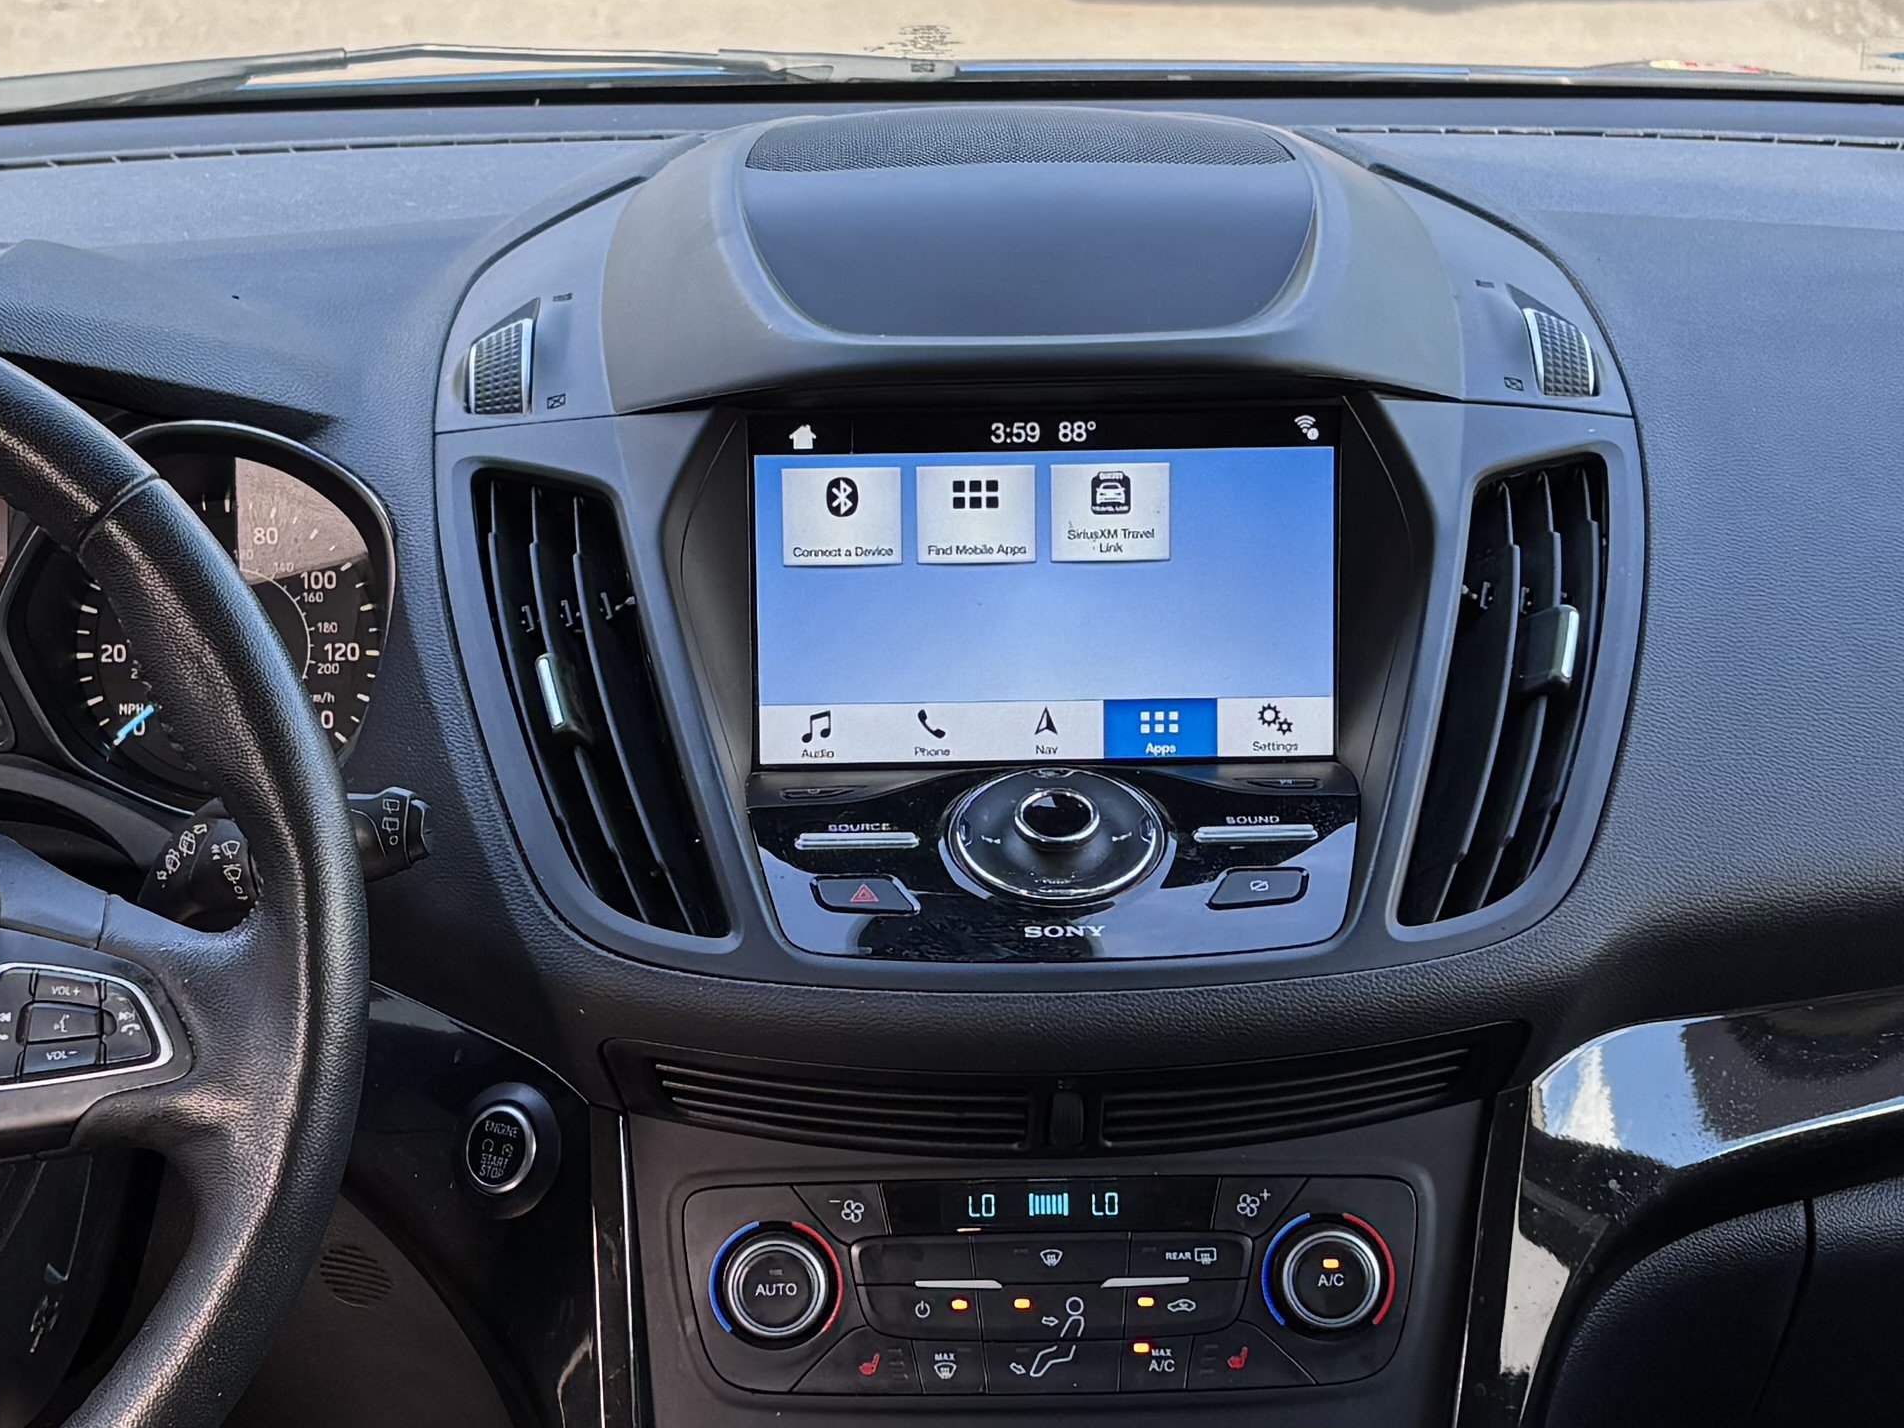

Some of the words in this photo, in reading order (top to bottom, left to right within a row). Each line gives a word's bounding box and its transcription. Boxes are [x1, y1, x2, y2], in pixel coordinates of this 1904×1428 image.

[991, 422, 1041, 443] 3:59
[1058, 421, 1097, 442] 88°
[253, 527, 278, 545] 80
[1067, 529, 1119, 541] SiriusXM
[1121, 528, 1155, 539] Travel
[793, 546, 842, 557] Connect
[844, 548, 852, 557] a
[855, 546, 894, 557] Device
[928, 545, 953, 556] Find
[955, 544, 995, 556] Mobile
[997, 544, 1027, 557] Apps
[1099, 542, 1123, 553] Link
[300, 571, 337, 590] 100
[303, 592, 324, 603] 160
[317, 622, 338, 633] 180
[101, 644, 127, 663] 20
[323, 642, 360, 661] 120
[317, 662, 339, 674] 200
[119, 703, 144, 716] MPH
[914, 746, 951, 757] Phone
[1035, 745, 1058, 756] Nav
[1146, 743, 1177, 756] Apps
[1252, 741, 1299, 753] Settings
[801, 749, 835, 759] Audio
[1226, 815, 1280, 825] SOUND
[828, 822, 892, 832] SOURCE
[1024, 925, 1106, 938] SONY
[484, 1119, 519, 1138] ENGINE
[481, 1153, 509, 1169] START
[479, 1164, 504, 1179] STOP
[968, 1193, 995, 1217] LO
[1091, 1192, 1119, 1216] LO
[1165, 1251, 1192, 1261] REAR
[1317, 1273, 1345, 1287] A/C
[755, 1283, 798, 1297] AUTO
[935, 1353, 956, 1361] MAX
[1151, 1348, 1172, 1357] MAX
[1148, 1359, 1176, 1373] A/C
